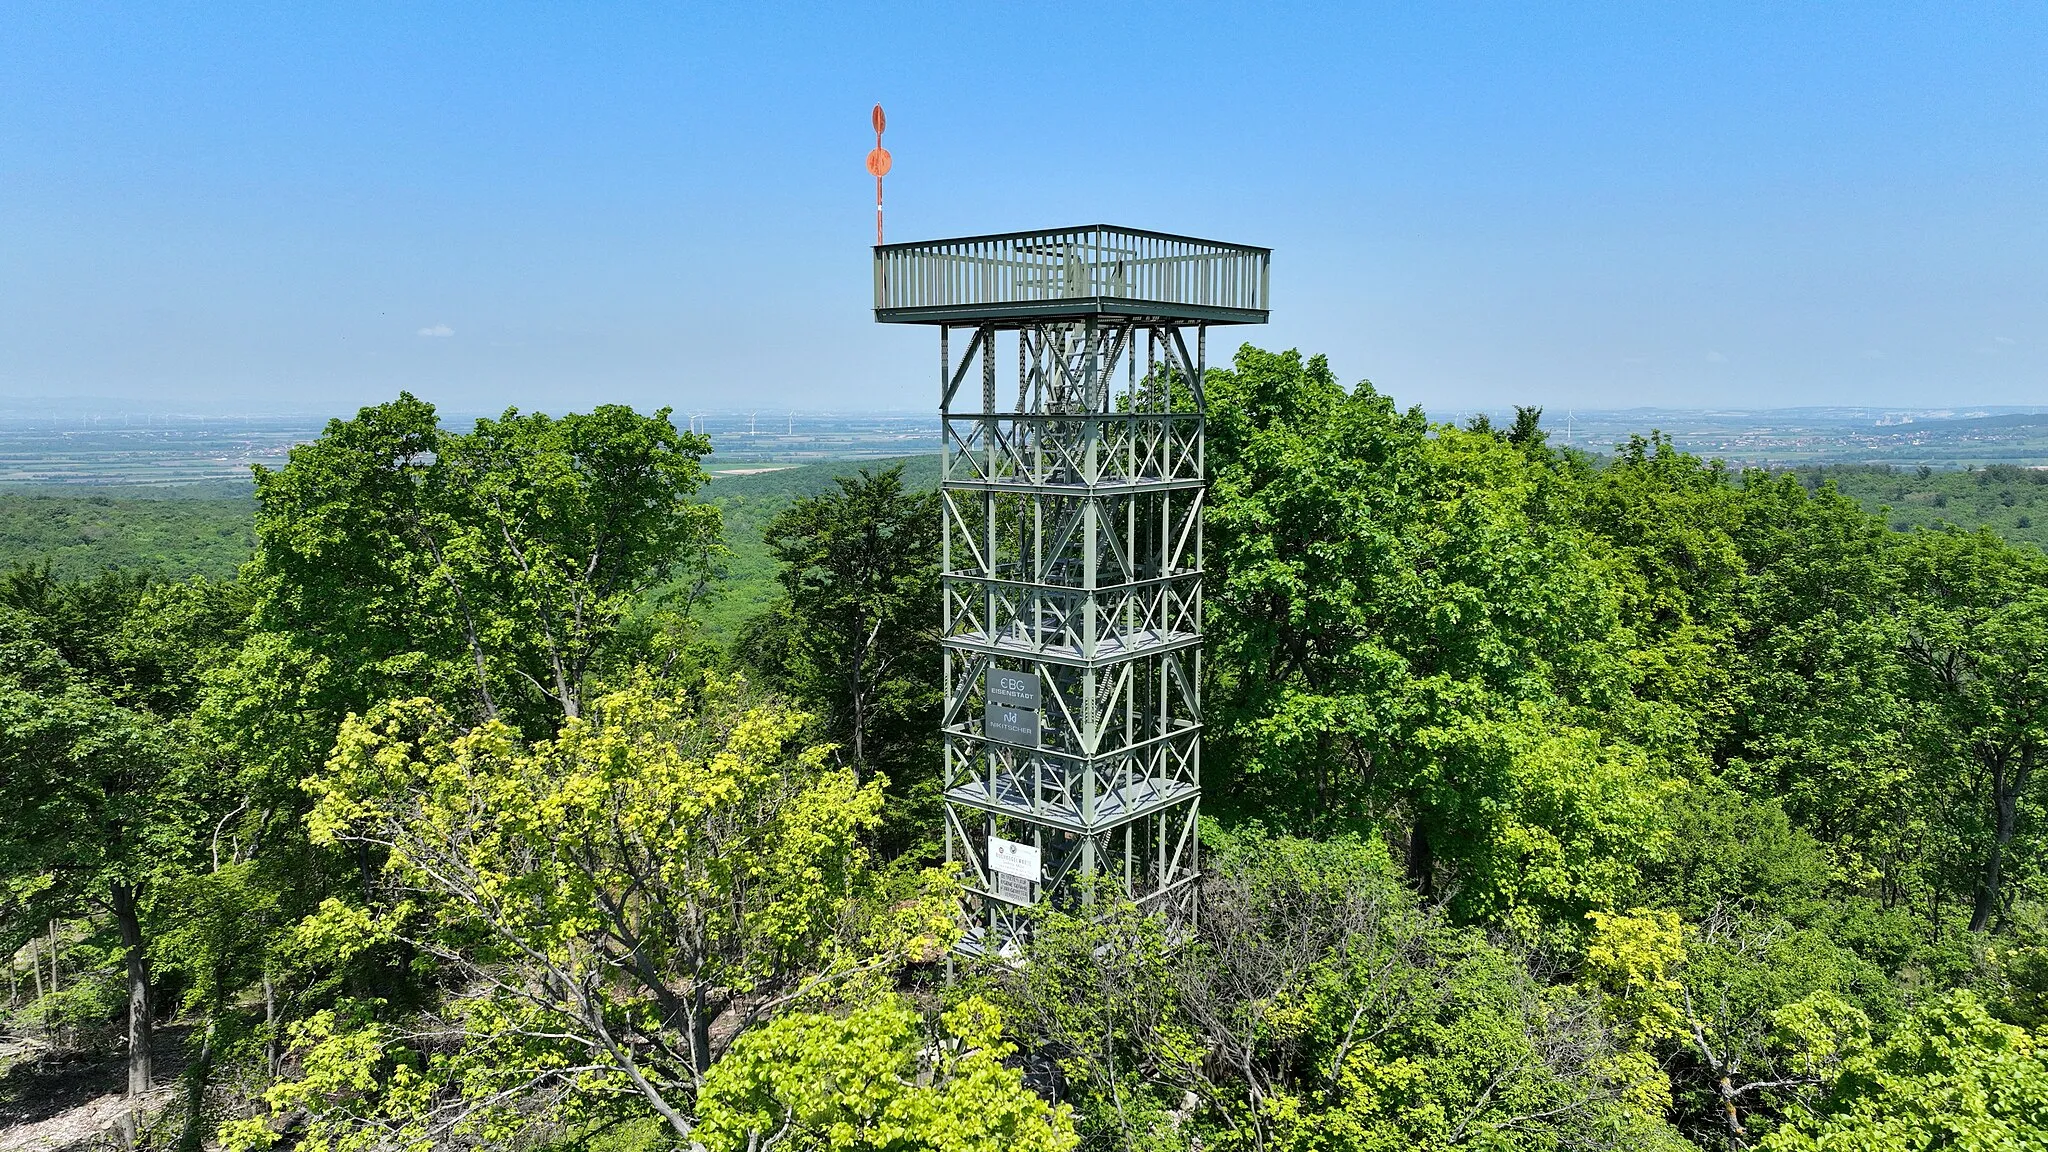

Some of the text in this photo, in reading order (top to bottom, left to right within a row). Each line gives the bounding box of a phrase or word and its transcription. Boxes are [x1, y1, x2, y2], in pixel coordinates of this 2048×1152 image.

[1000, 677, 1025, 691] EBG
[991, 688, 1034, 700] EISENSTADT
[990, 721, 1032, 734] NIKITSCHER
